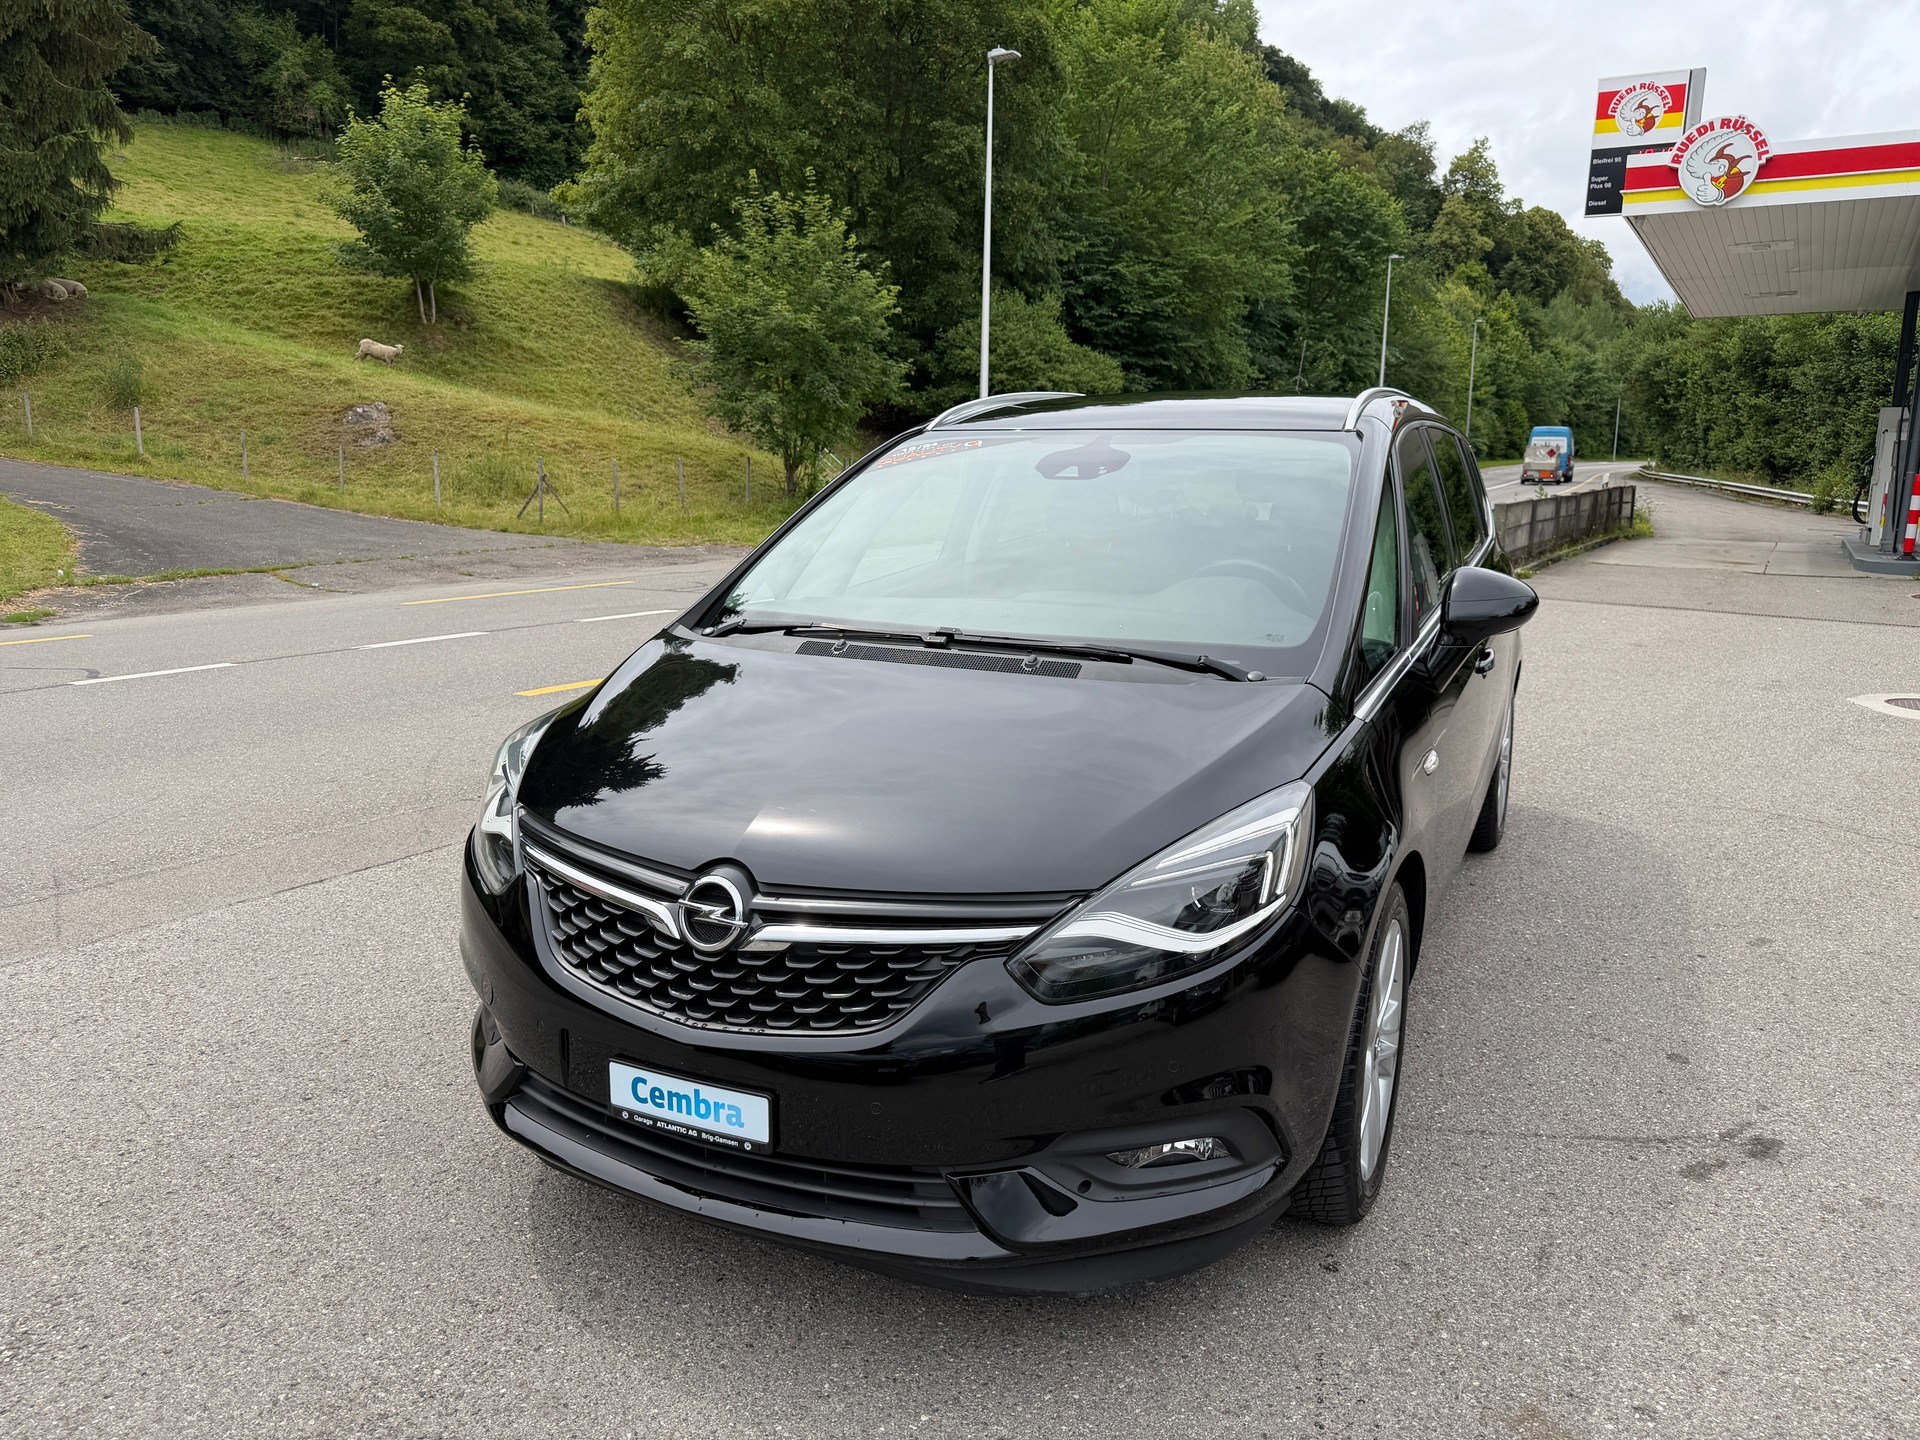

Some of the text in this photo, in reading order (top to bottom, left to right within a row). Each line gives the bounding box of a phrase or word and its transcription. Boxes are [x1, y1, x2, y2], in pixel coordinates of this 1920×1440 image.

[1610, 81, 1670, 113] RUEDI RÜSSEL
[1671, 115, 1770, 165] RUEDI RÜSSEL
[631, 1076, 745, 1129] Cembra
[633, 1114, 739, 1147] Garage ATLANTIC AG Brig-Gamsen
